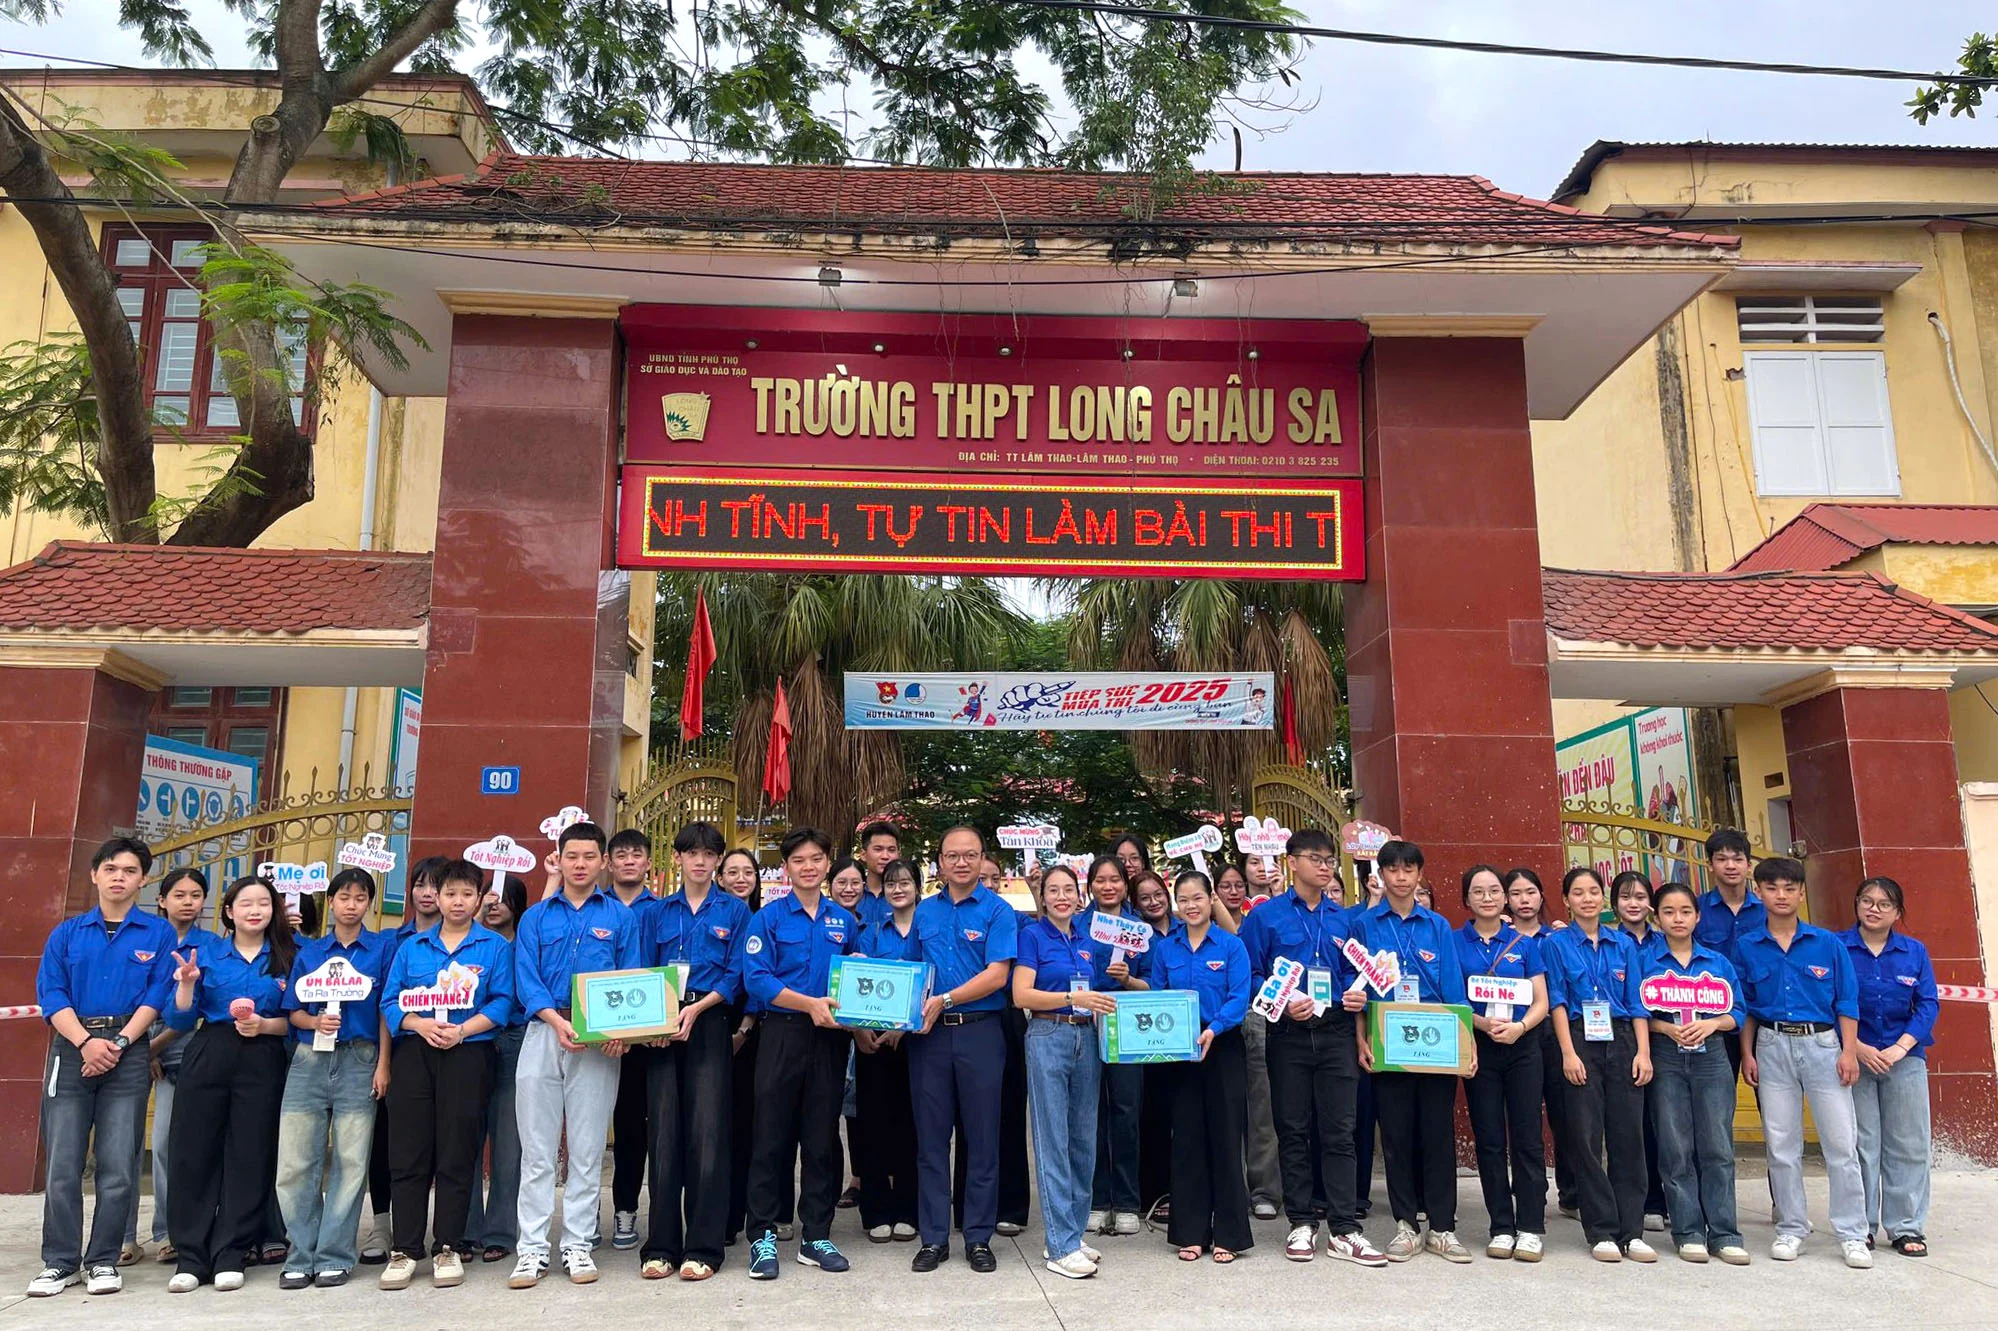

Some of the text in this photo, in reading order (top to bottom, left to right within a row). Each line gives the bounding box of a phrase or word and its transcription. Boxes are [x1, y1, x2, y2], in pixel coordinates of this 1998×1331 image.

[649, 354, 675, 363] UBND
[732, 368, 747, 378] TẠO
[751, 364, 1343, 444] TRƯỜNG THPT LONG CHÂU SA
[958, 451, 976, 463] ĐỊA
[1006, 453, 1018, 462] TT
[1021, 451, 1043, 463] LÂM
[1102, 454, 1127, 464] THAO
[1160, 455, 1179, 467] THỌ
[1262, 456, 1286, 465] 0210
[1298, 456, 1317, 466] 825
[1320, 456, 1340, 466] 235
[721, 493, 839, 548] TĨNH,
[856, 503, 923, 548] TỰ
[936, 505, 1010, 543] TIN
[1025, 498, 1118, 545] LÀM
[1135, 500, 1207, 546] BÀI
[1221, 511, 1293, 547] THI
[1306, 512, 1335, 548] T
[1136, 678, 1232, 704] 2025
[1105, 697, 1134, 708] THI
[915, 711, 935, 719] THAO
[147, 754, 232, 783] THÔNG THƯỜNG GẶP
[489, 771, 512, 789] 90
[485, 853, 515, 868] Nghiệp
[279, 866, 325, 883] Mẹ ơi
[1347, 943, 1367, 968] CHIẾN
[1263, 959, 1291, 1000] Ba ơi
[402, 989, 429, 1007] CHIẾN
[1697, 986, 1725, 1004] CÔNG
